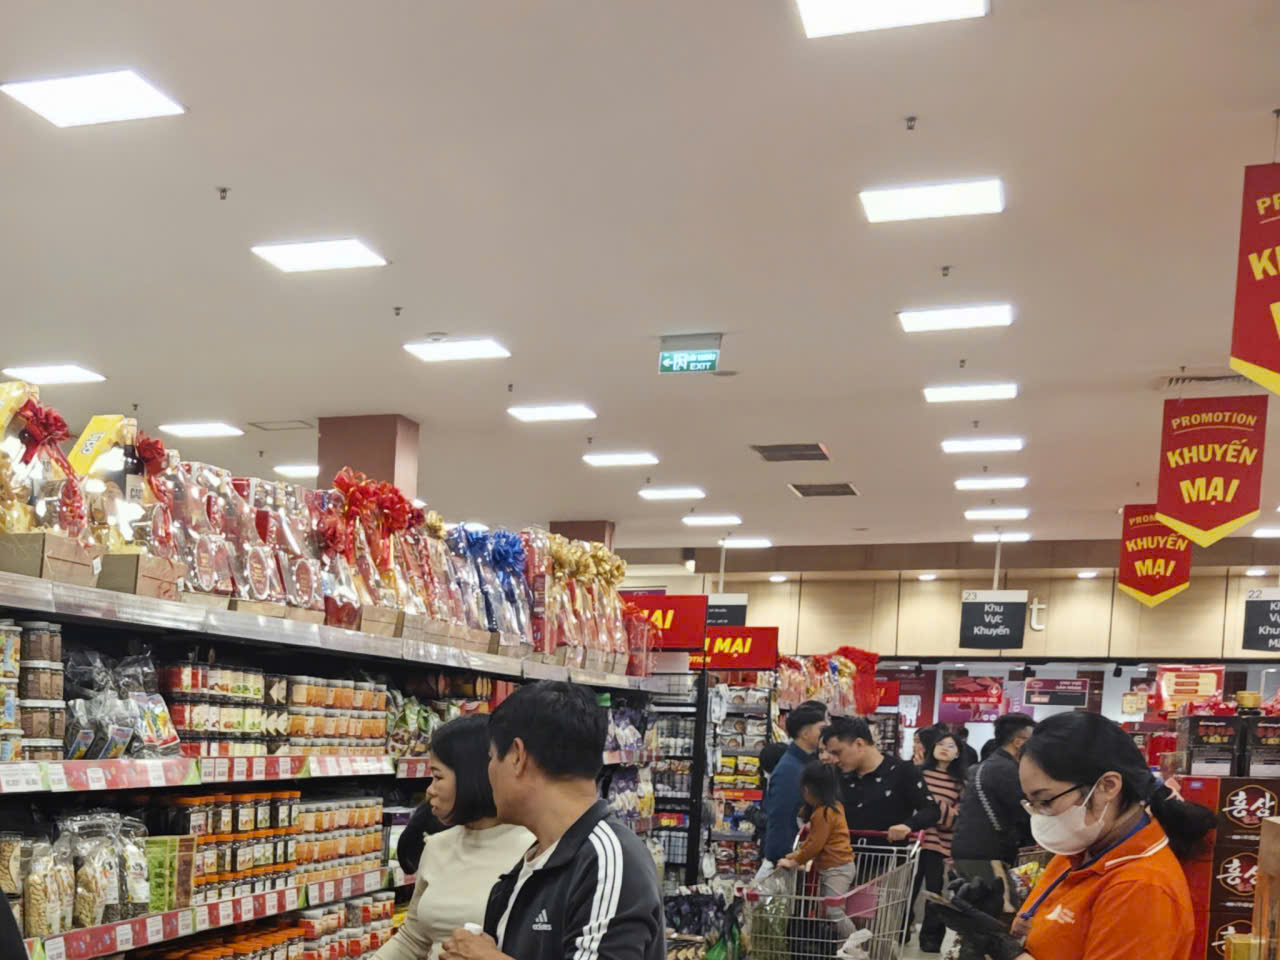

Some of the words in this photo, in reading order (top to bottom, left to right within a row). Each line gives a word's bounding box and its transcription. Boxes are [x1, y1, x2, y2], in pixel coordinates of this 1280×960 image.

[689, 362, 712, 371] EXIT
[1171, 411, 1257, 430] PROMOTION
[1166, 438, 1258, 468] KHUYẾN
[1179, 476, 1240, 506] MẠI
[1125, 532, 1189, 552] KHUYẾN
[1134, 558, 1177, 579] MẠI
[964, 591, 978, 601] 23
[1247, 589, 1263, 599] 22
[713, 637, 753, 658] MẠI
